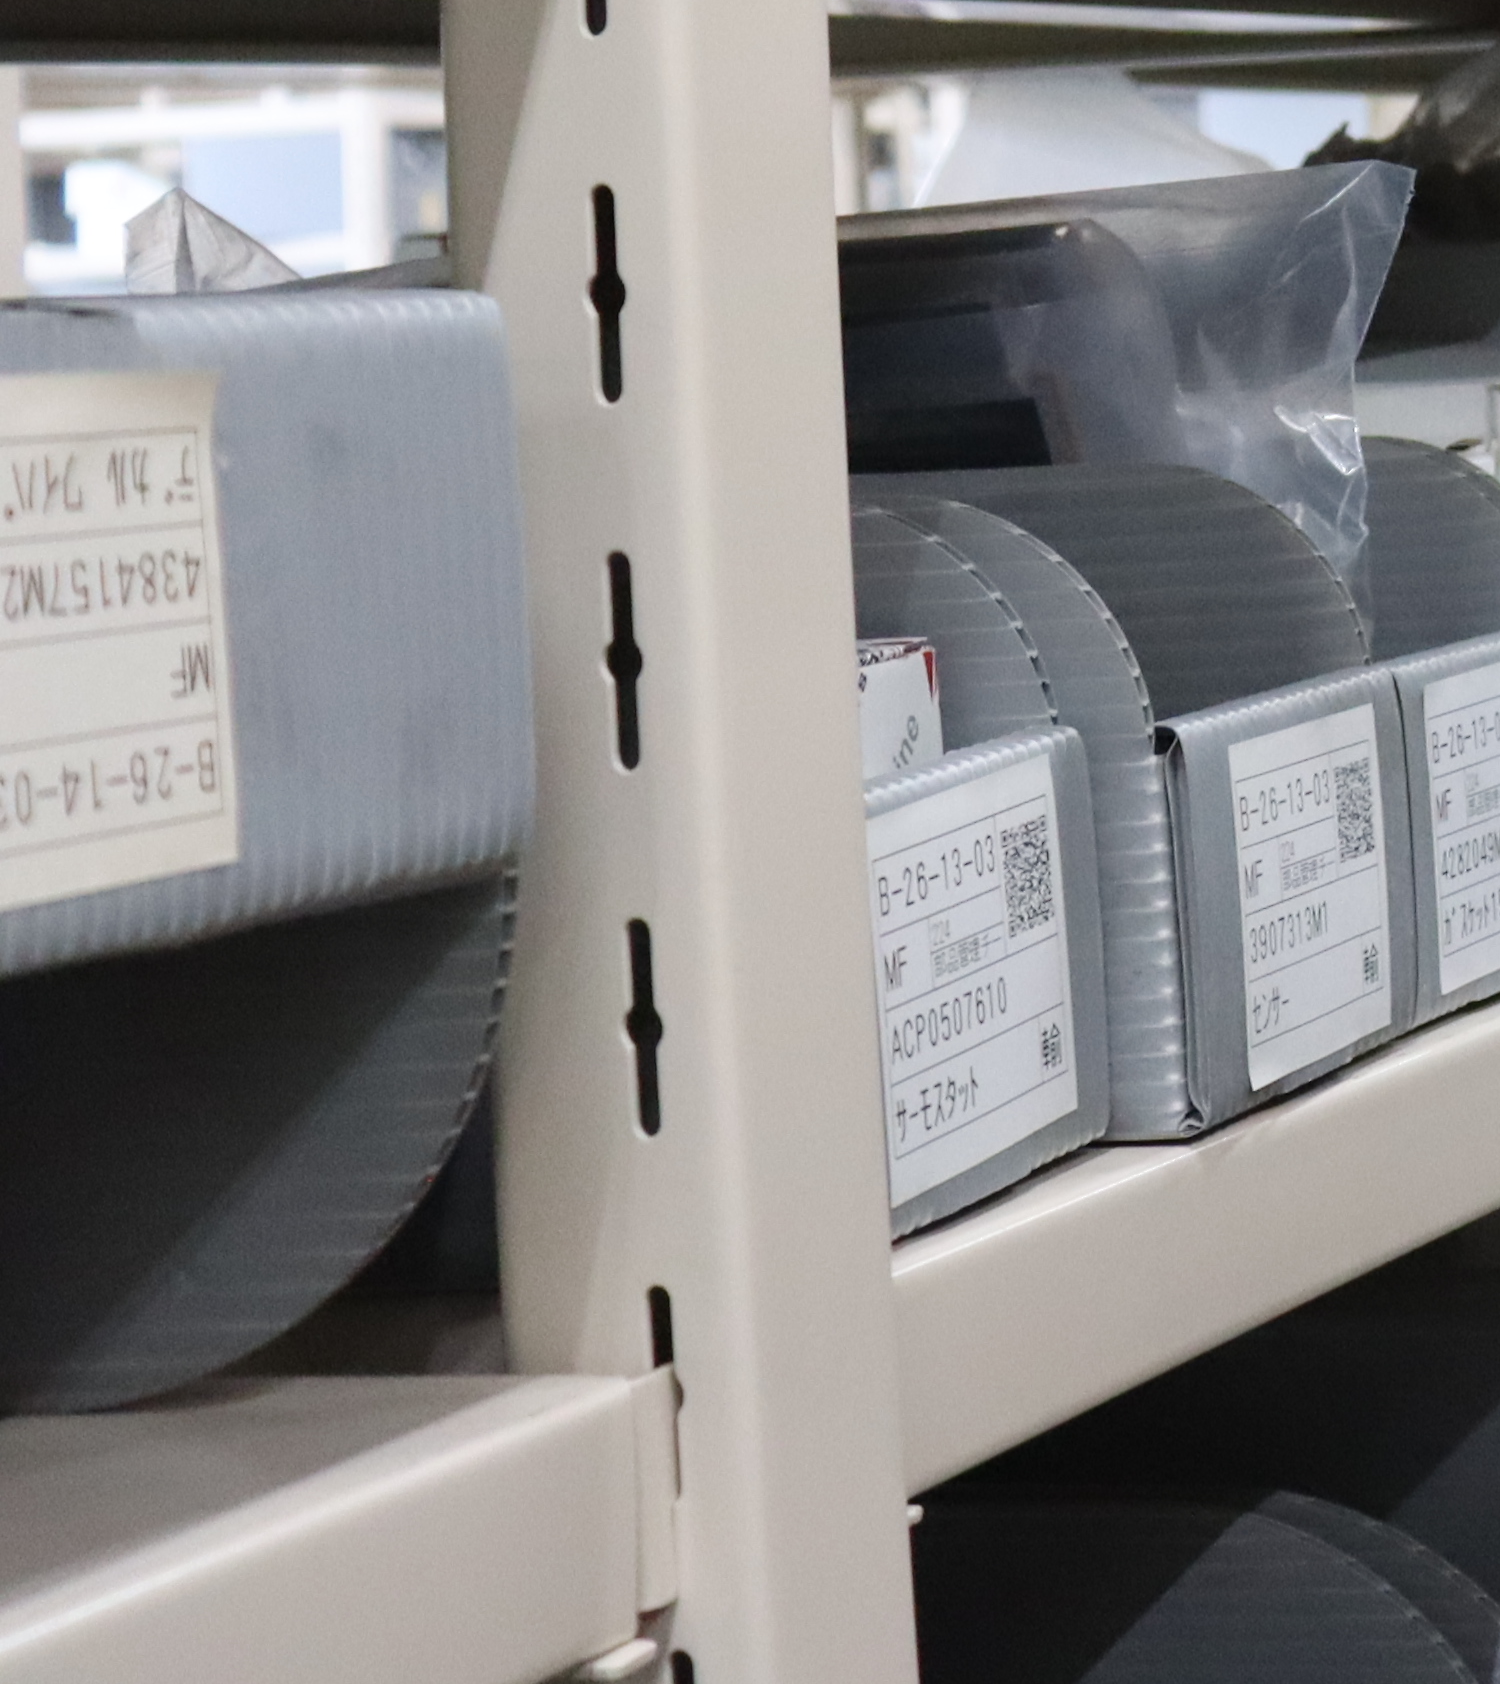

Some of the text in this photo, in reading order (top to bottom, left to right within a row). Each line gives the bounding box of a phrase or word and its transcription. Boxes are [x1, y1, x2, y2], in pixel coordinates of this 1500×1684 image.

[0, 548, 201, 619] 4384157M2
[170, 643, 211, 699] MF
[1238, 771, 1331, 833] B-26-13-03
[1436, 788, 1453, 819] MF
[878, 833, 996, 917] B-26-13-03
[1241, 857, 1264, 898] MF
[1249, 900, 1329, 965] 3907313M1
[884, 946, 909, 989] MF
[890, 975, 1009, 1064] ACP0507610
[895, 1065, 981, 1144] サーモスタット
